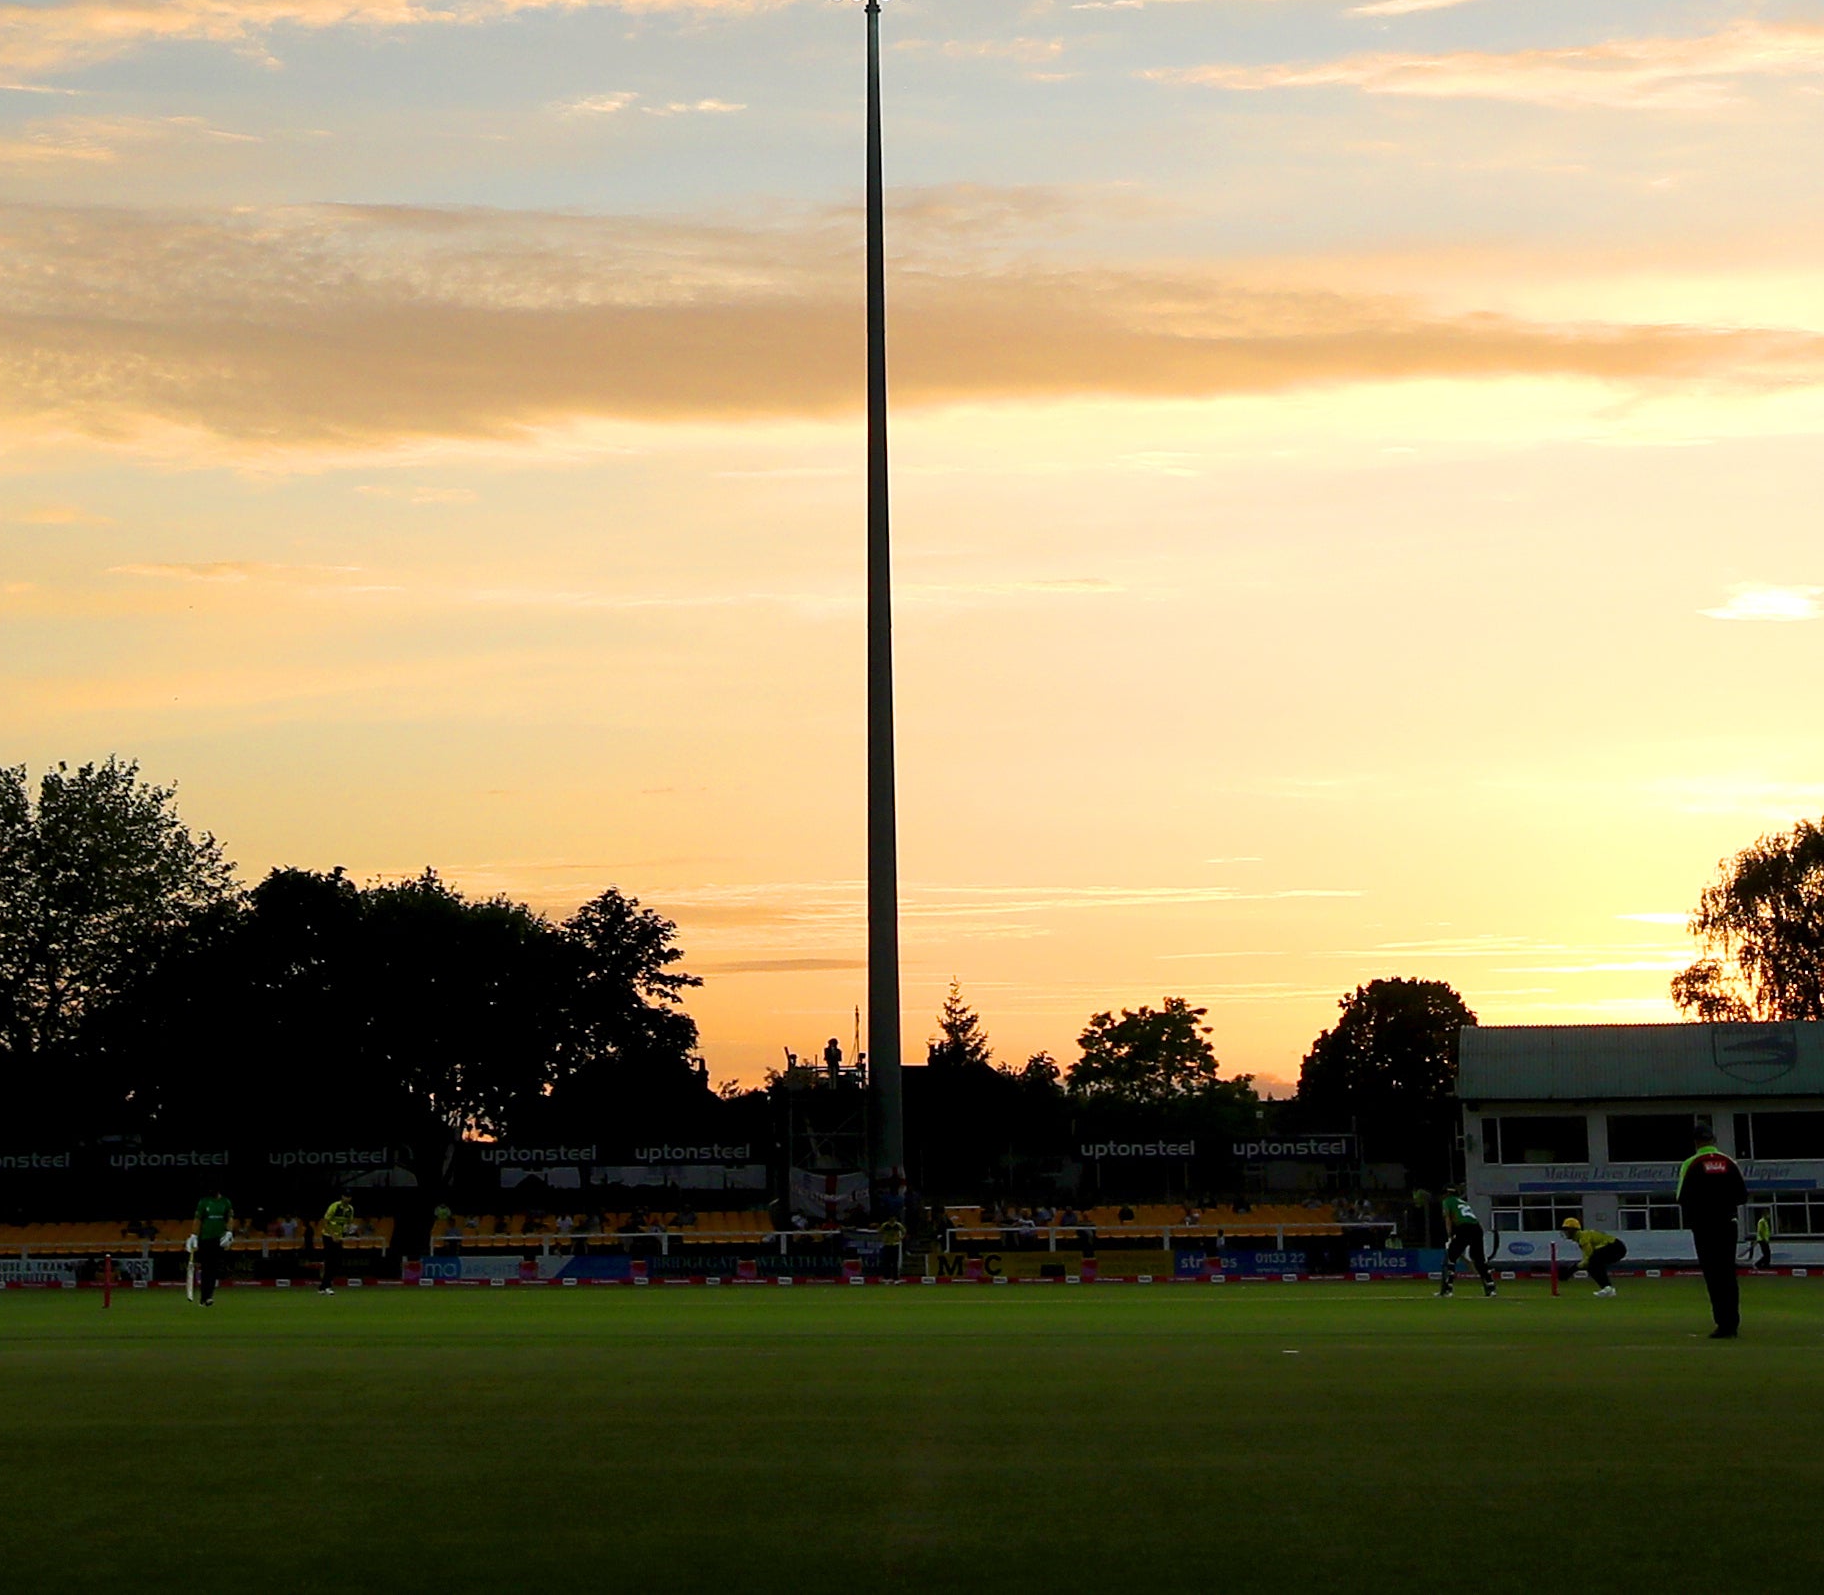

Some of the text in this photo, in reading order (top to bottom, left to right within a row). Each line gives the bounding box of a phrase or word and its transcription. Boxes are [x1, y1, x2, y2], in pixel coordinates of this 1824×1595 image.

[269, 1147, 388, 1168] uptonsteel
[480, 1143, 596, 1164] uptonsteel
[635, 1142, 751, 1163] uptonsteel
[1080, 1139, 1195, 1160] uptonsteel
[1233, 1138, 1347, 1159] uptonsteel
[110, 1149, 229, 1170] uptonsteel
[1544, 1167, 1589, 1181] Making
[1592, 1166, 1625, 1179] Lives
[127, 1261, 150, 1275] 365
[1181, 1252, 1238, 1269] stres
[1349, 1249, 1408, 1268] strikes
[425, 1262, 458, 1277] ma
